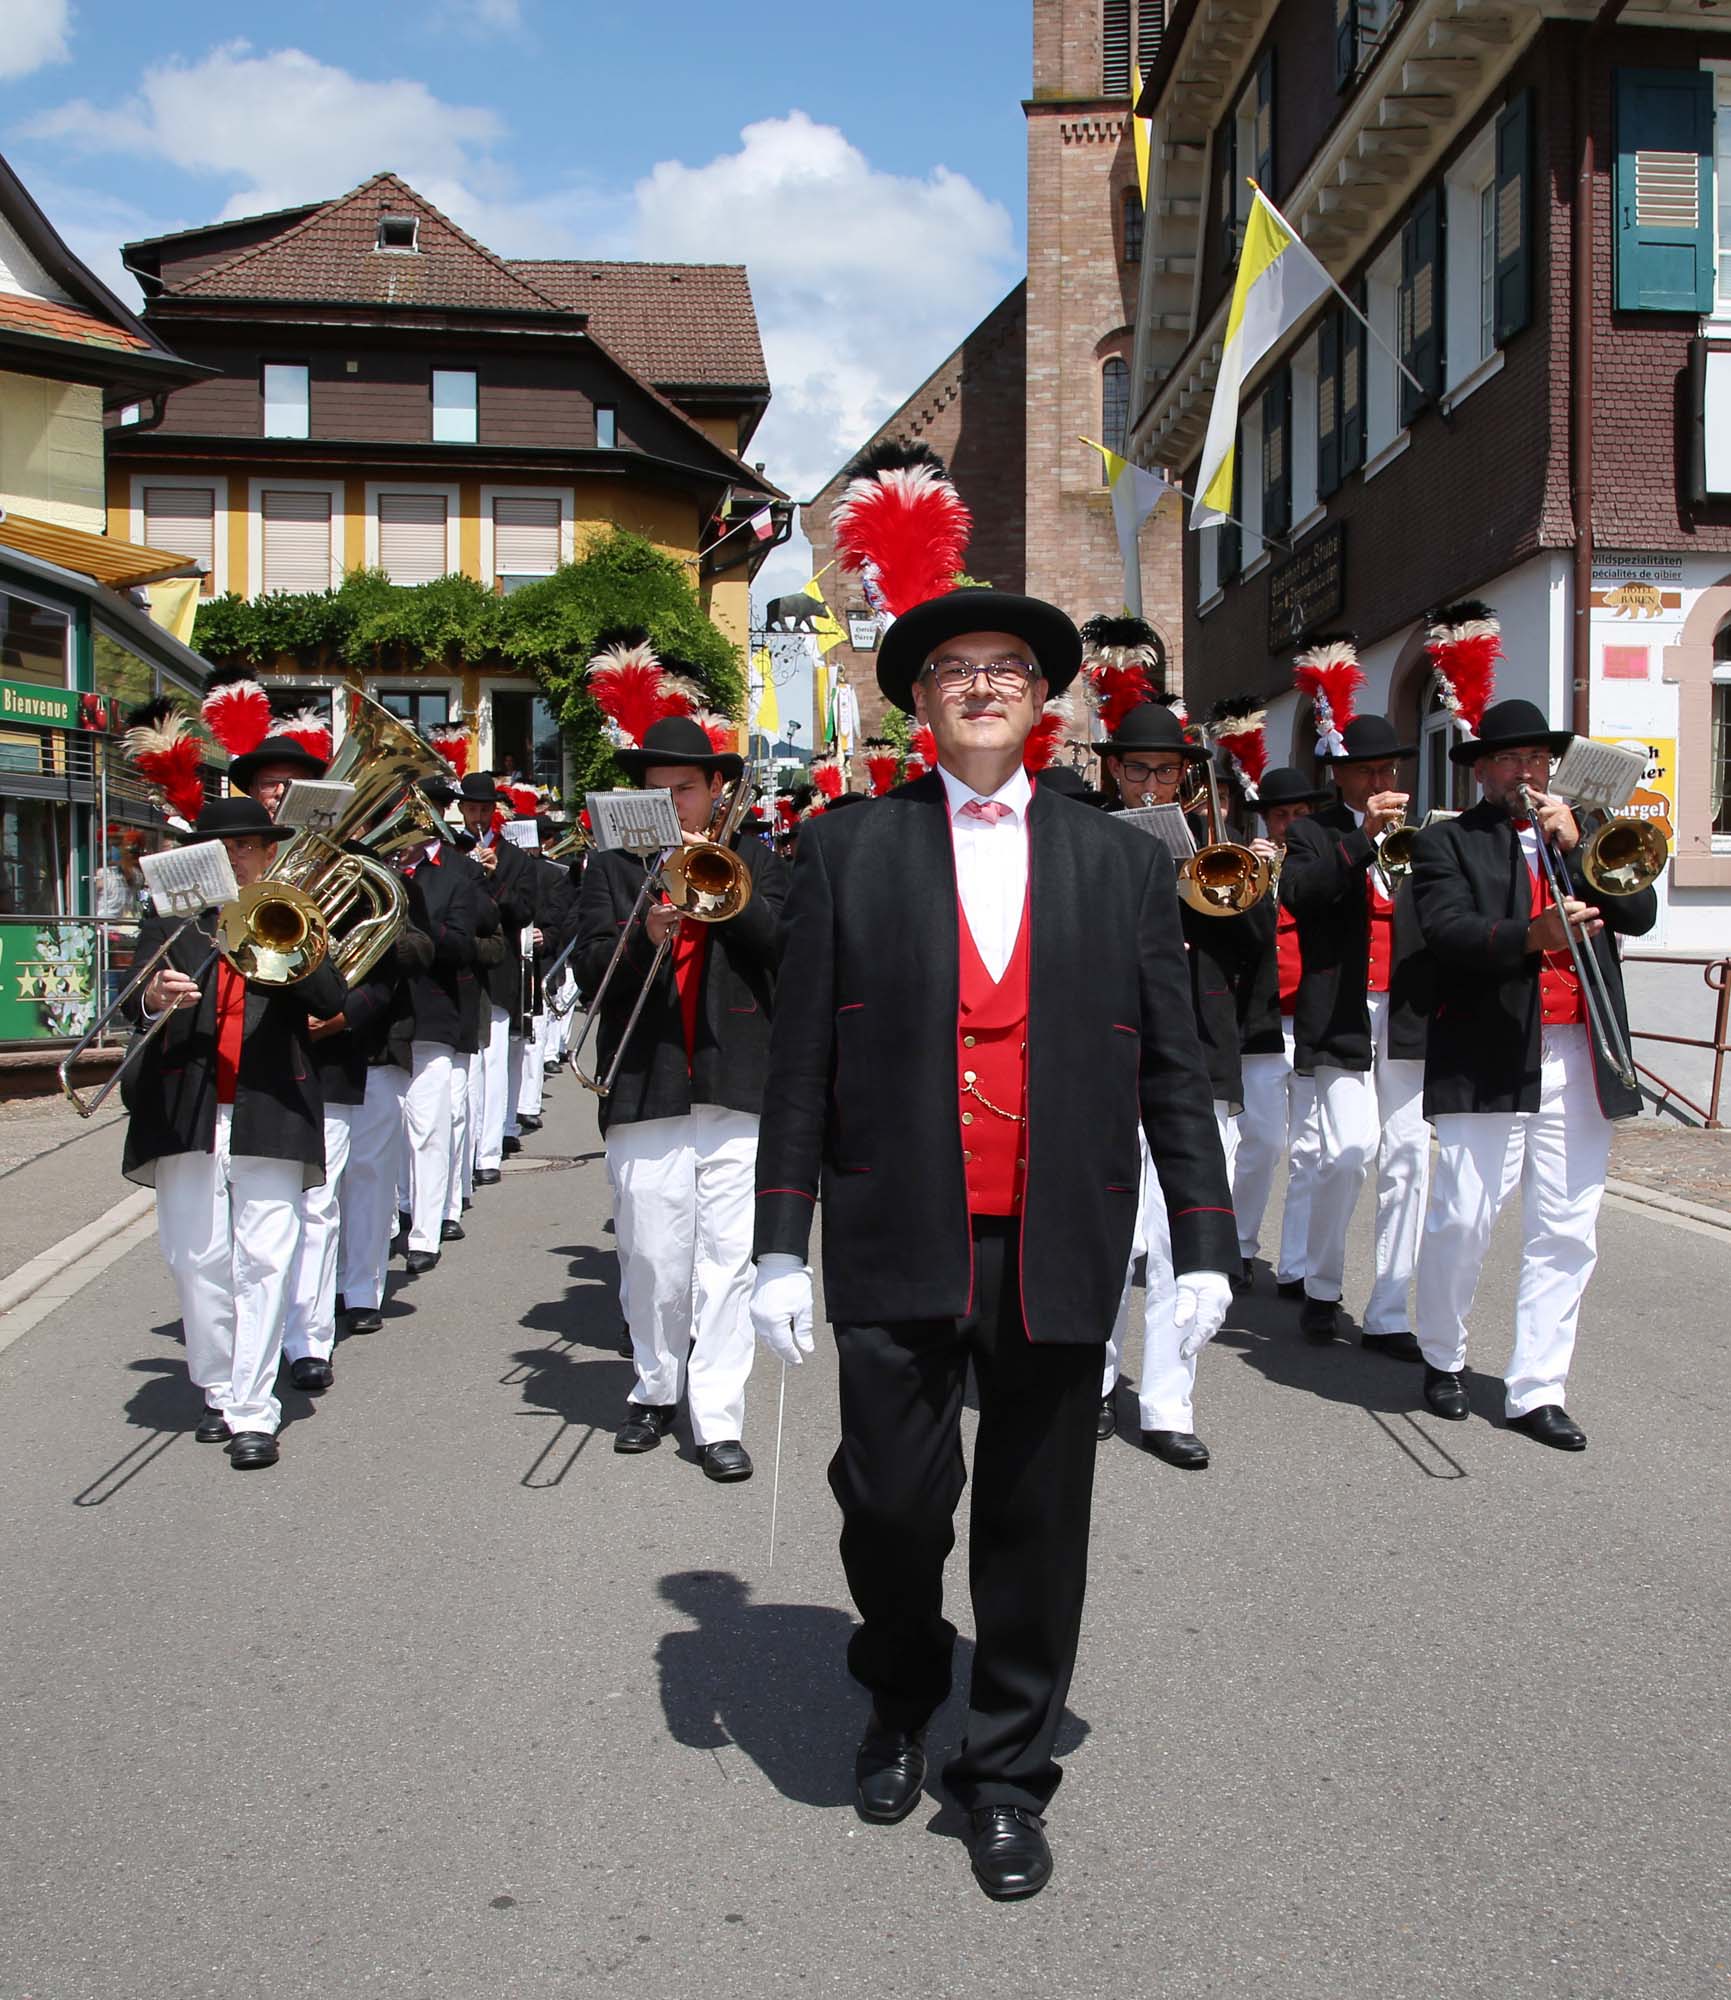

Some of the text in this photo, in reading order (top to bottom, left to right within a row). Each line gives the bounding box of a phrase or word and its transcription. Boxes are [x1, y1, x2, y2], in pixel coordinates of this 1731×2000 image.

[1593, 569, 1682, 579] pécialités de gibier
[1623, 585, 1653, 593] HOTEL
[4, 688, 68, 719] Bienvenue
